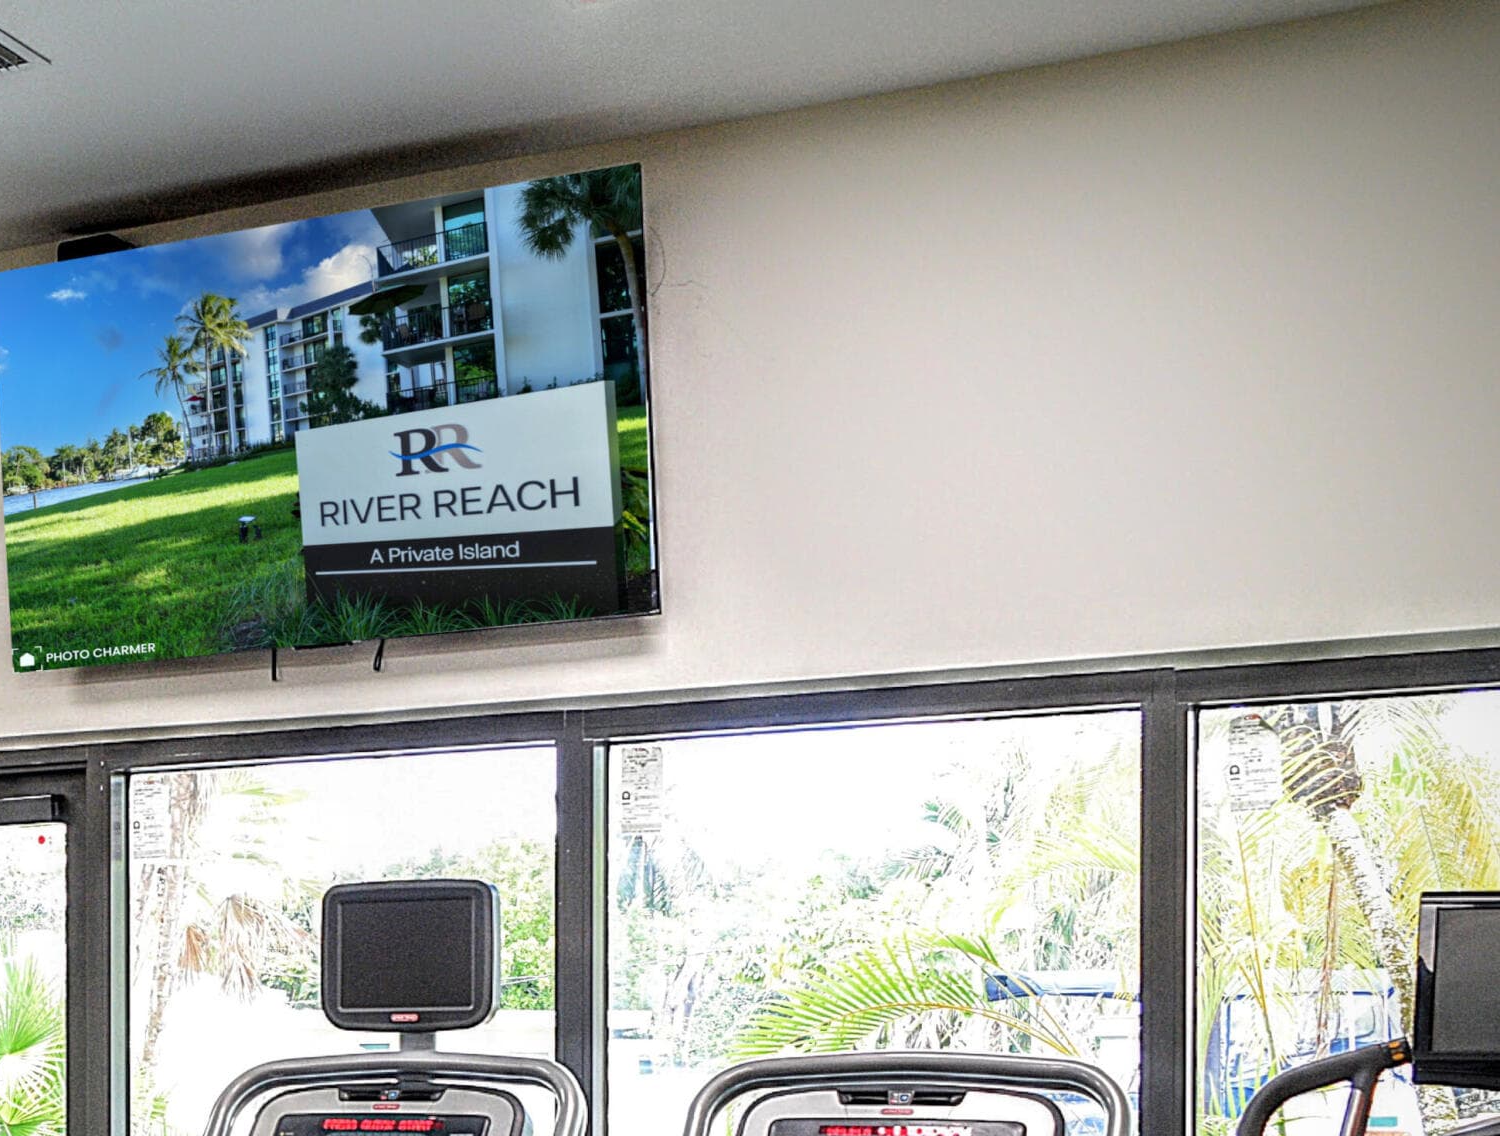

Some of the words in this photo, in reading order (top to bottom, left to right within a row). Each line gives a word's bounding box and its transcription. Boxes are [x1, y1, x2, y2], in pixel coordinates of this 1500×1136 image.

[319, 493, 421, 527] RIVER
[434, 476, 580, 518] REACH
[369, 548, 384, 564] A
[388, 544, 454, 564] Private
[458, 540, 520, 561] Island
[45, 649, 90, 662] PHOTO
[92, 642, 156, 658] CHARMER
